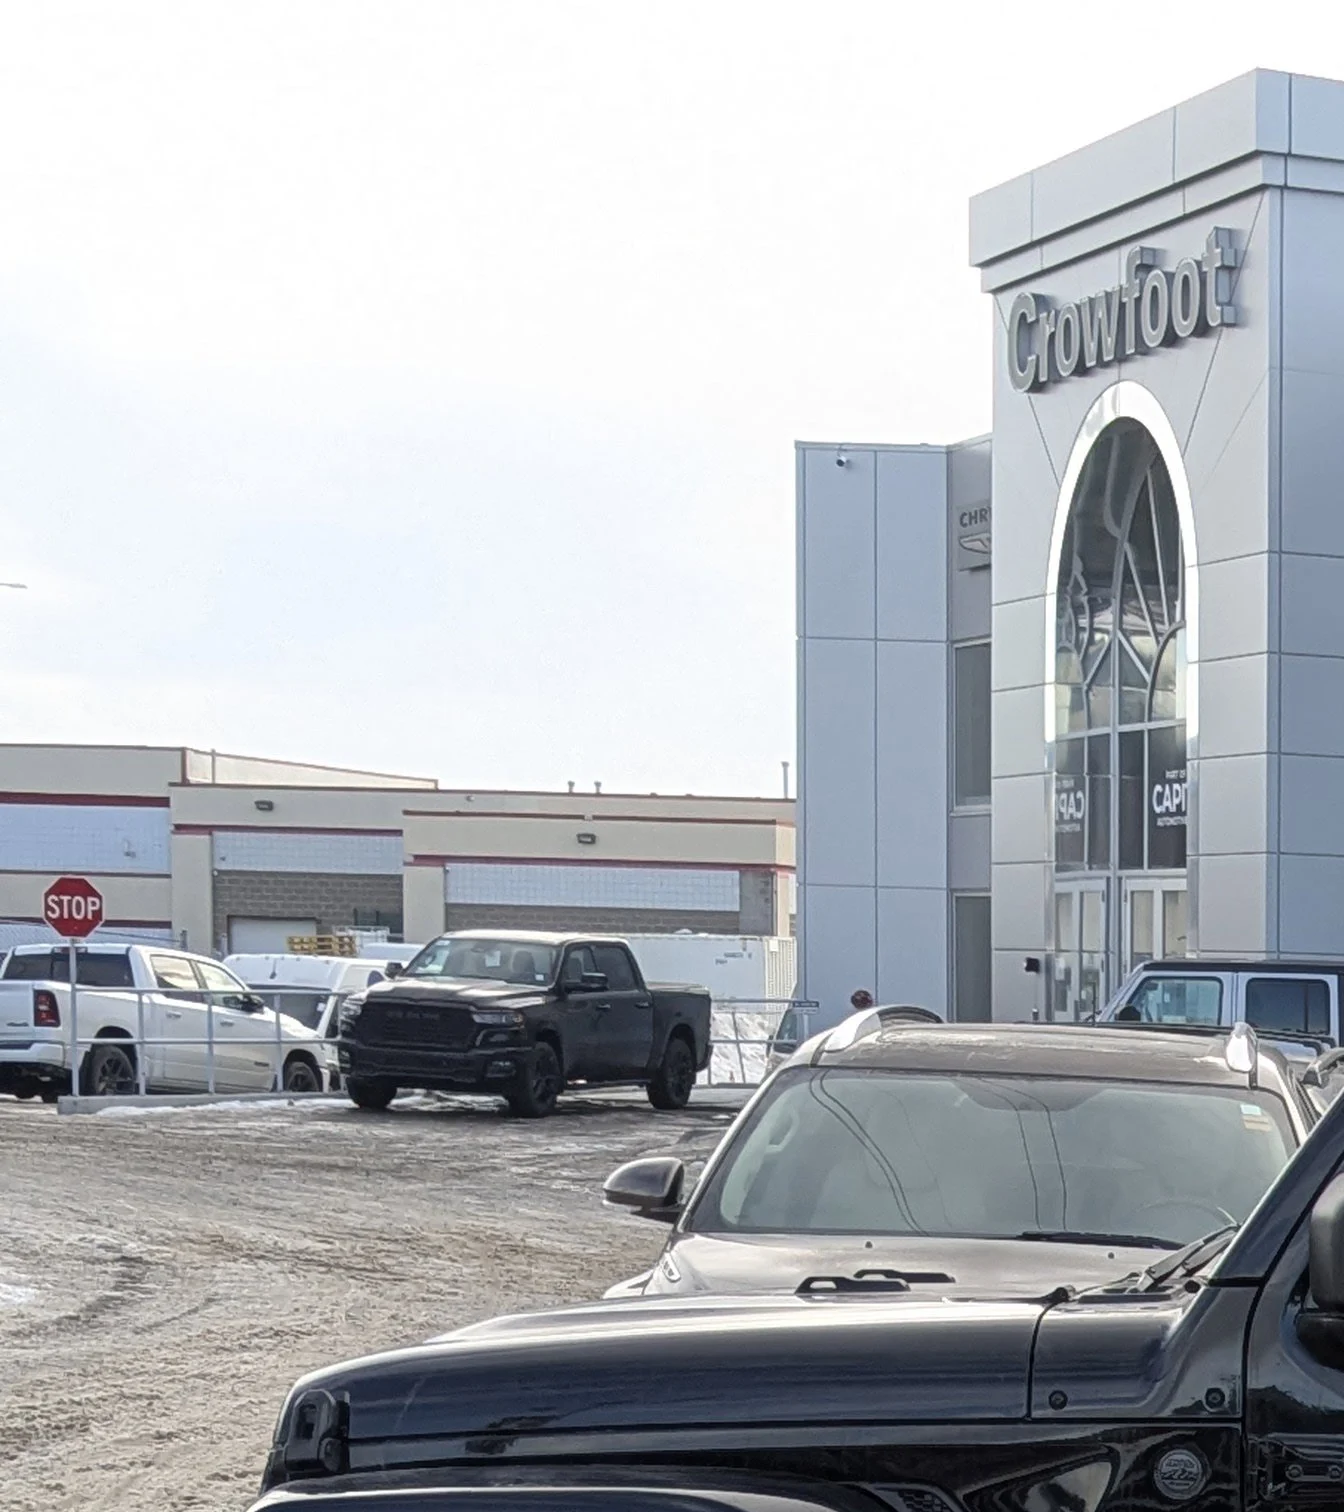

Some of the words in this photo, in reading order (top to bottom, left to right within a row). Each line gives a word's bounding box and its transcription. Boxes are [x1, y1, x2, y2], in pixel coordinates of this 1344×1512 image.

[1007, 226, 1237, 393] Crowfoot
[959, 505, 992, 528] CHR
[1152, 782, 1187, 813] CAPI
[47, 894, 101, 920] STOP
